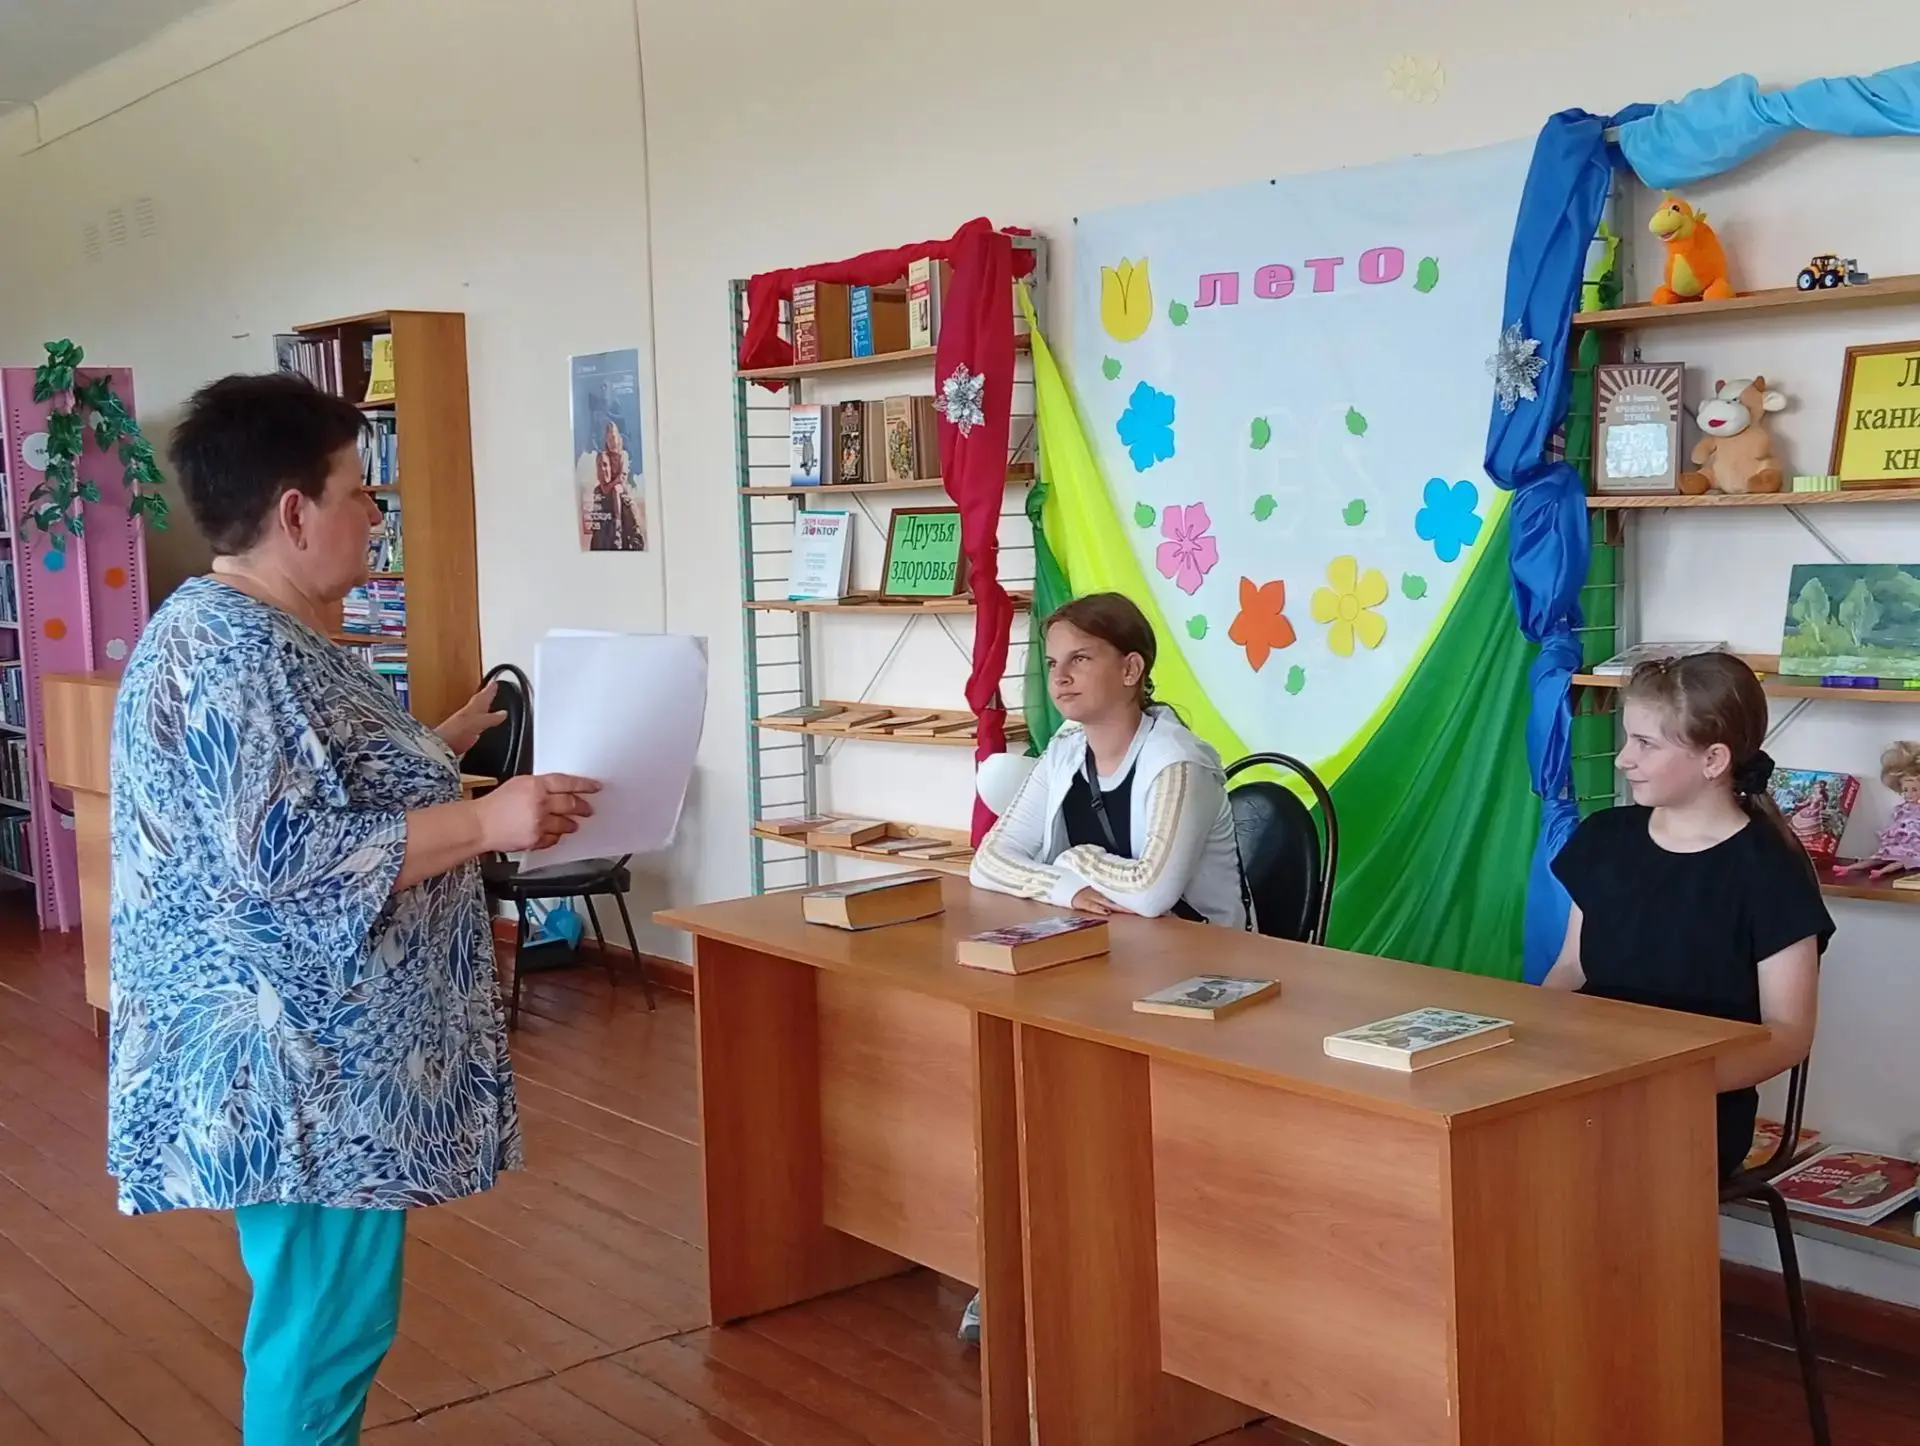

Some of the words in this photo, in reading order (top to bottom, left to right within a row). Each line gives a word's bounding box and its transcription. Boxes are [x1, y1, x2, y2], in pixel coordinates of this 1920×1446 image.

[1194, 246, 1405, 308] лето
[901, 516, 955, 550] Друзья
[891, 561, 957, 588] здоровья
